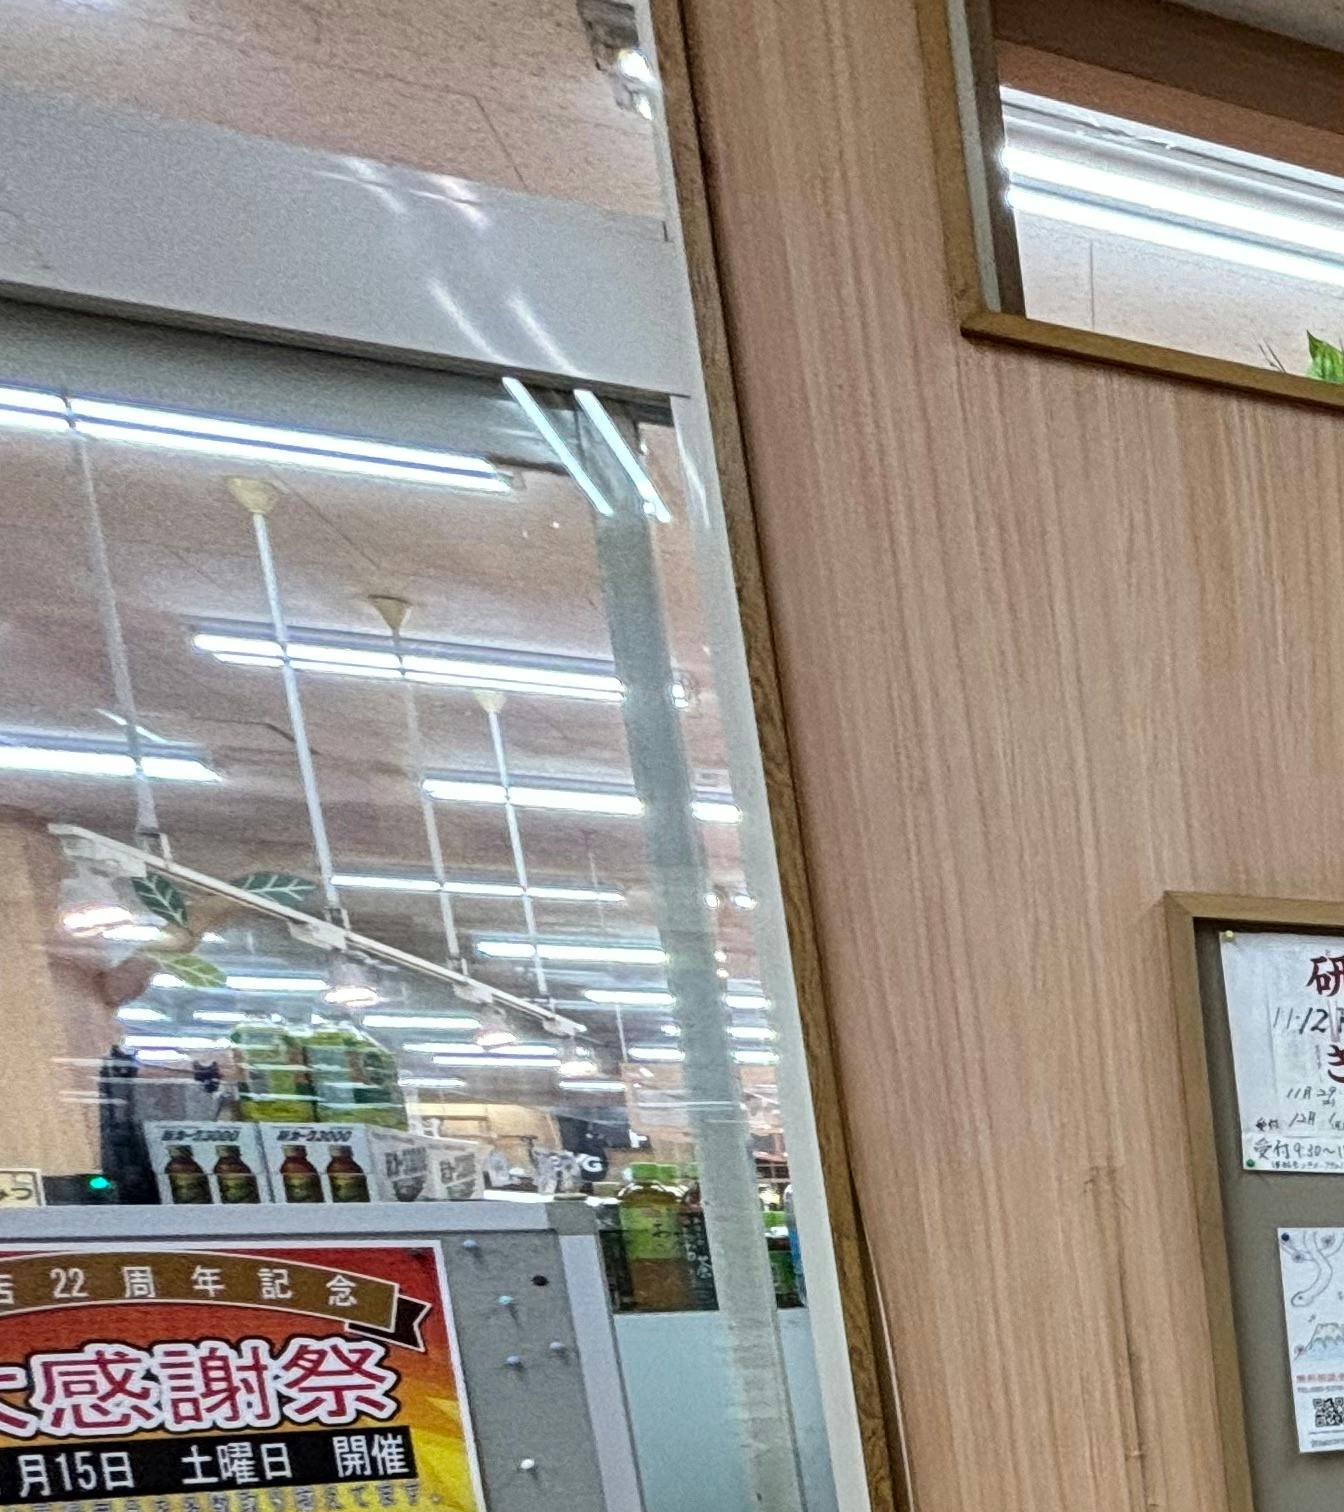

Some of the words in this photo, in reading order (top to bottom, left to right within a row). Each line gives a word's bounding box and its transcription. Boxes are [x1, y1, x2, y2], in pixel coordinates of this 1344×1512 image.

[181, 1441, 292, 1487] 土曜日
[333, 1434, 410, 1478] 開催
